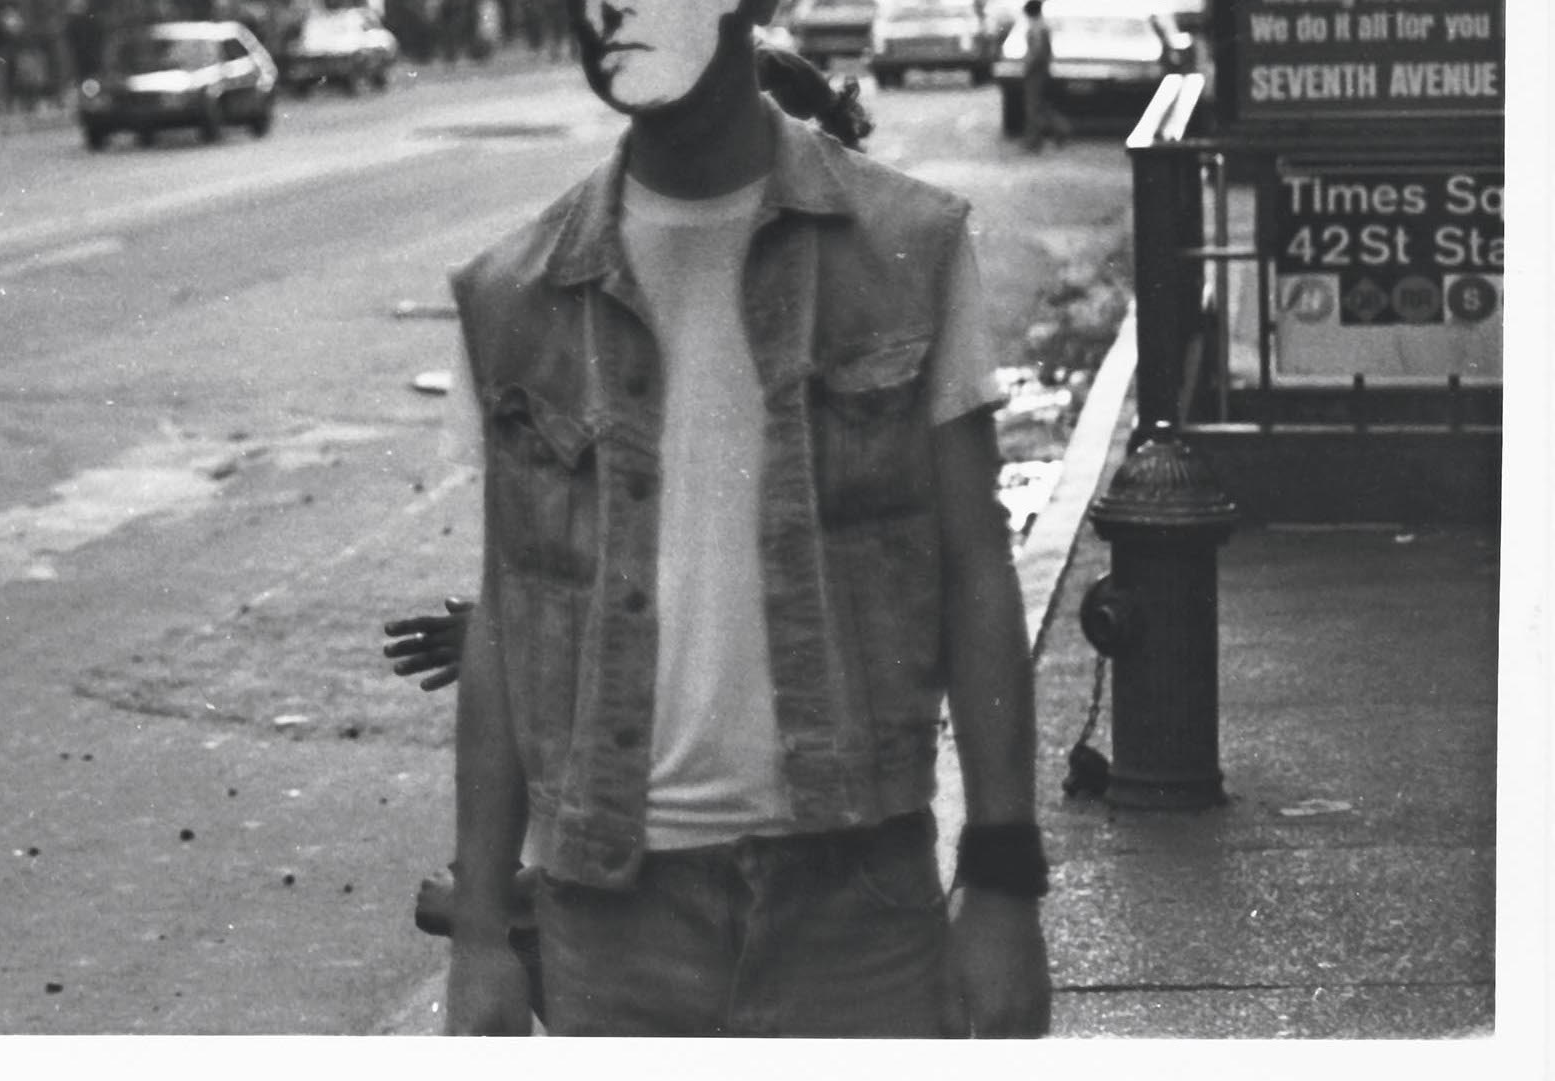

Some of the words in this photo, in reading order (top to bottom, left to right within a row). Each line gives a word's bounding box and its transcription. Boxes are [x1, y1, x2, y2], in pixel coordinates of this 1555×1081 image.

[1250, 13, 1289, 43] We
[1296, 12, 1328, 43] do
[1334, 11, 1351, 41] it
[1357, 11, 1389, 41] all
[1396, 10, 1435, 40] for
[1444, 12, 1491, 42] you
[1251, 62, 1378, 102] SEVENTH
[1389, 61, 1499, 98] AVENUE
[1282, 176, 1427, 214] Times
